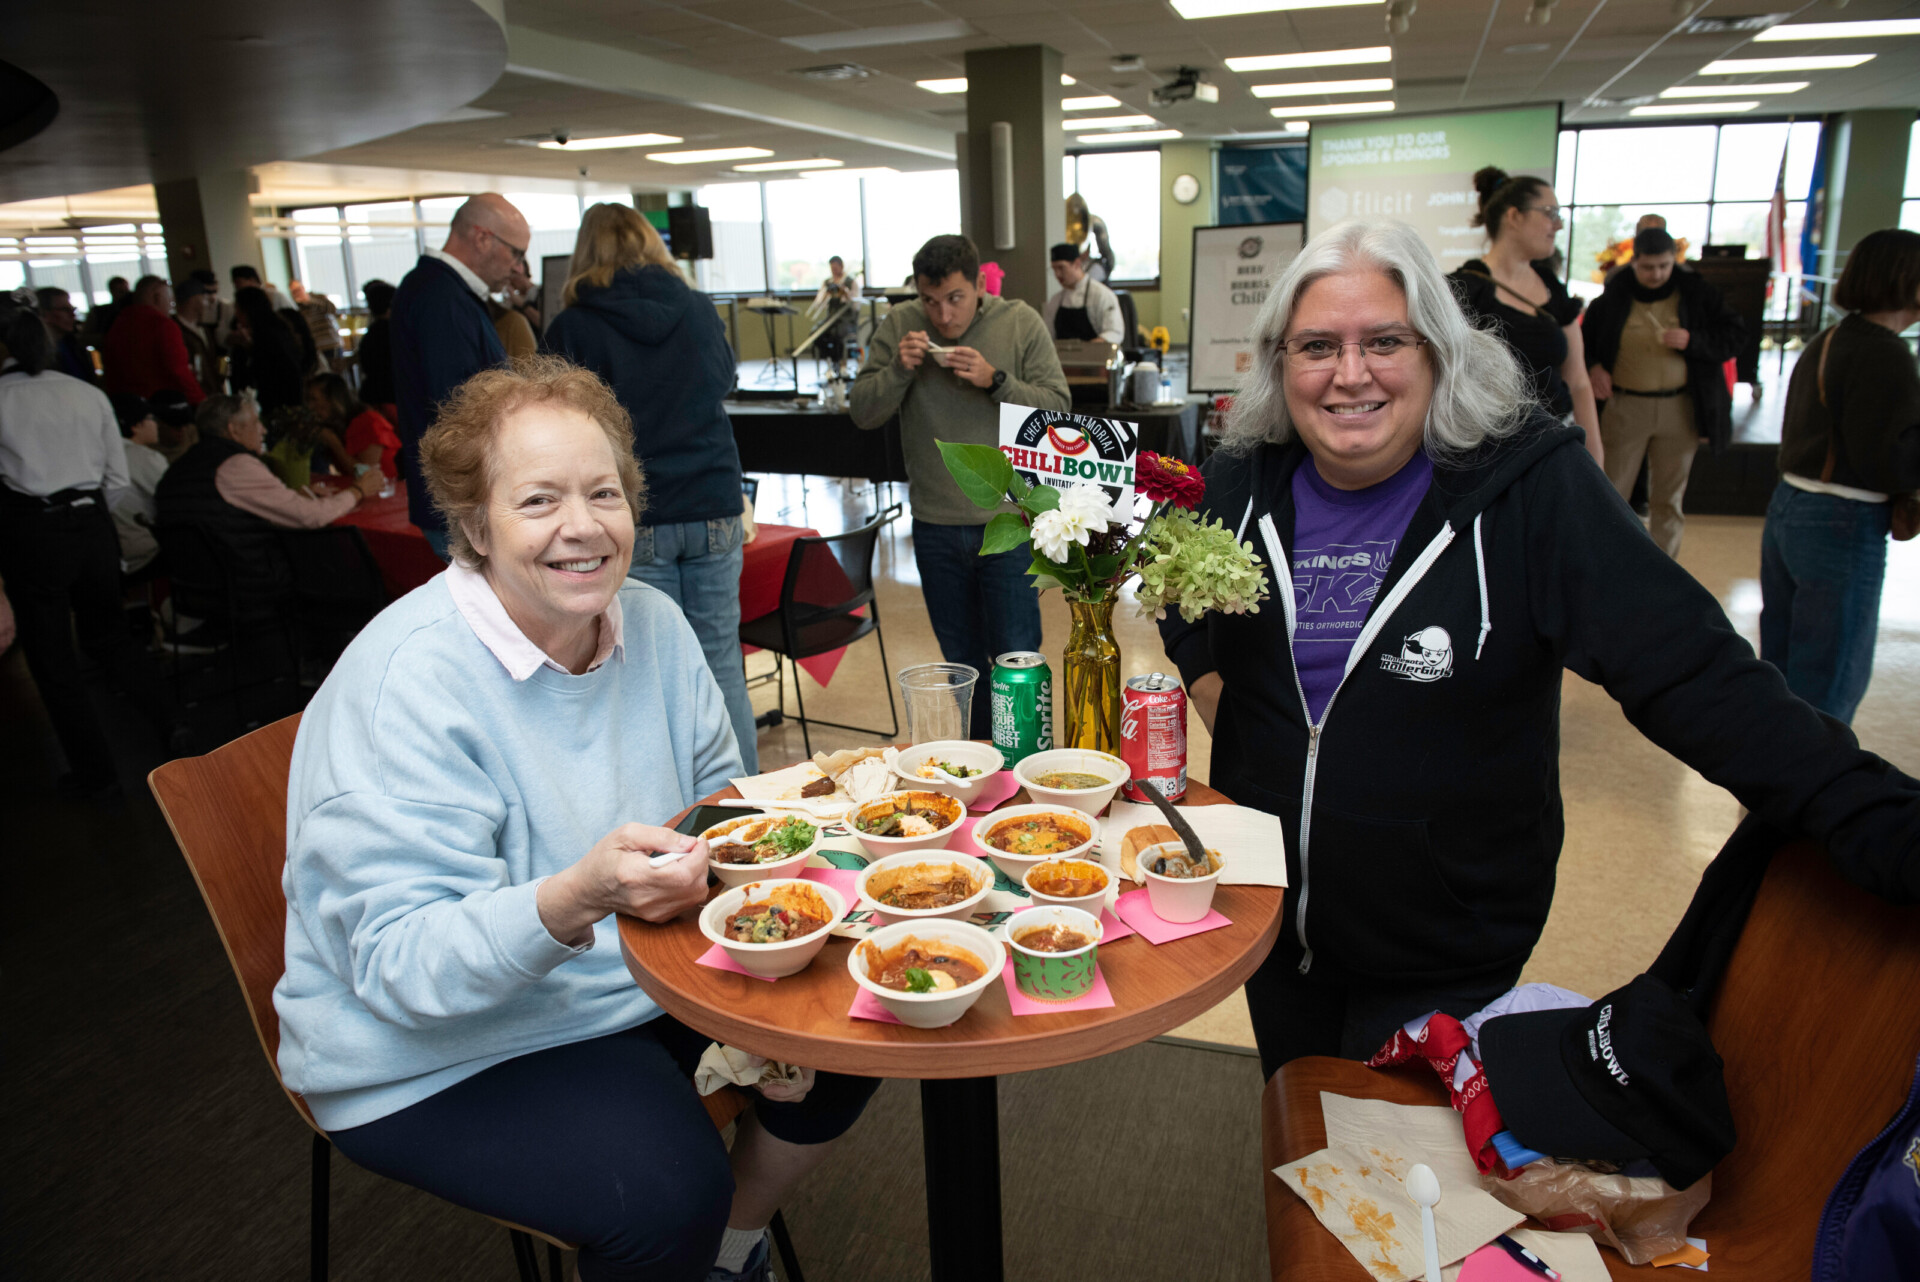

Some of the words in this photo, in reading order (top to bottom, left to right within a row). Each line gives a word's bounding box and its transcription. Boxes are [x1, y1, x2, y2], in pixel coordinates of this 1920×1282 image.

[1322, 138, 1364, 152] THANK
[1366, 135, 1394, 149] YOU
[1397, 133, 1415, 146] TO
[1417, 131, 1446, 145] OUR
[1394, 145, 1450, 162] DONORS
[1023, 417, 1042, 442] CHEF
[1041, 410, 1071, 426] JACKS
[1073, 414, 1116, 455] MEMORIAL
[1293, 552, 1371, 570] KINGS
[1382, 654, 1424, 665] Minnesota
[992, 680, 1010, 692] Sprite
[1148, 694, 1168, 704] Coke
[1036, 680, 1053, 751] Sprite
[1597, 1004, 1629, 1086] CHILIBOWL
